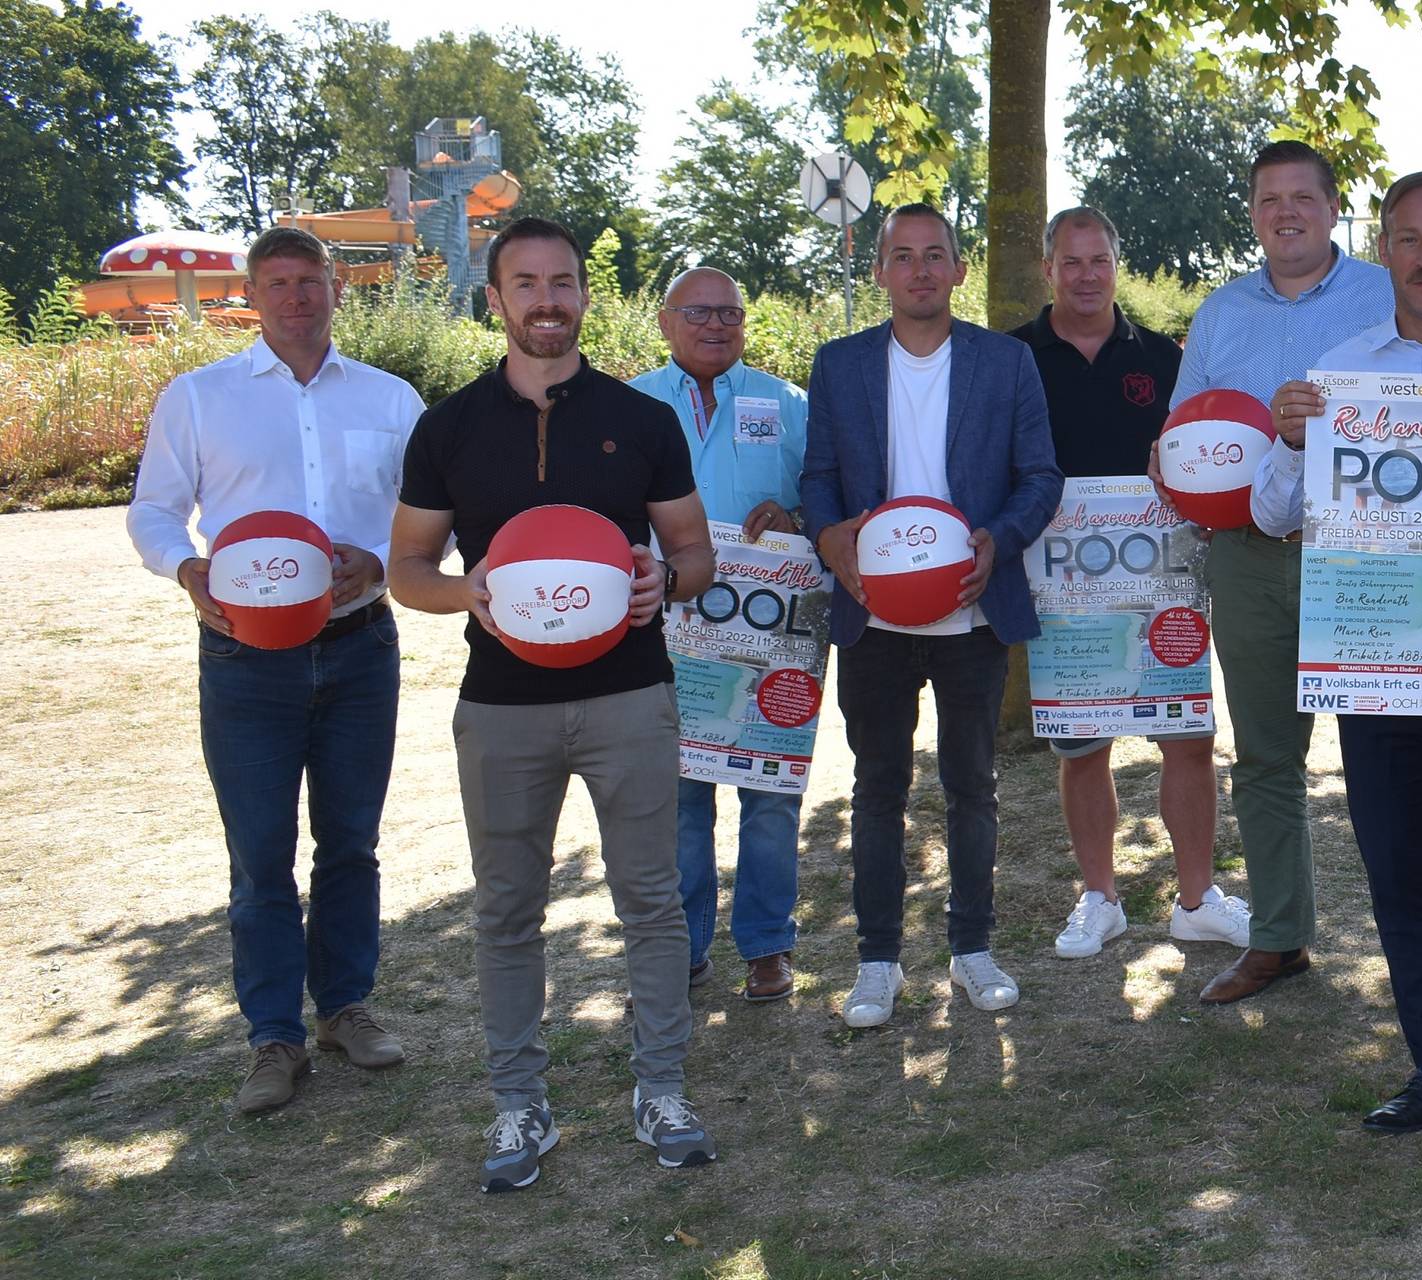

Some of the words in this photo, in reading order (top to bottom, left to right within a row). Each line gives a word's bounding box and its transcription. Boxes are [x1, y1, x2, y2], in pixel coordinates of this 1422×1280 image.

[1324, 378, 1360, 386] ELSDORF
[740, 422, 774, 435] POOL
[1332, 405, 1390, 442] Rock
[1212, 442, 1243, 466] 60
[1078, 483, 1151, 494] westenergie
[1089, 501, 1153, 527] around
[1322, 509, 1343, 521] 27.
[1350, 509, 1407, 523] AUGUST
[906, 524, 937, 546] 60
[1322, 528, 1371, 538] FREIBAD
[1044, 532, 1188, 577] POOL
[266, 557, 299, 580] 60
[719, 560, 788, 582] around
[787, 563, 822, 589] the
[1060, 582, 1103, 592] AUGUST
[1109, 581, 1135, 590] 2022
[1172, 579, 1194, 588] UHR
[521, 601, 552, 609] FREIBAD
[554, 596, 586, 607] ELSDORF
[552, 584, 590, 612] 60
[1082, 596, 1120, 604] ELSDORF
[675, 622, 722, 638] AUGUST
[726, 632, 754, 644] 2022
[793, 641, 815, 651] UHR
[695, 641, 736, 653] ELSDORF
[1347, 649, 1380, 660] Tribute
[1384, 651, 1393, 660] to
[1326, 678, 1380, 689] Volksbank
[1384, 680, 1402, 689] Erft
[1405, 681, 1420, 689] eG
[1302, 695, 1348, 708] RWE
[1392, 698, 1418, 708] OCH
[1037, 724, 1069, 734] RWE
[688, 751, 704, 761] Erft
